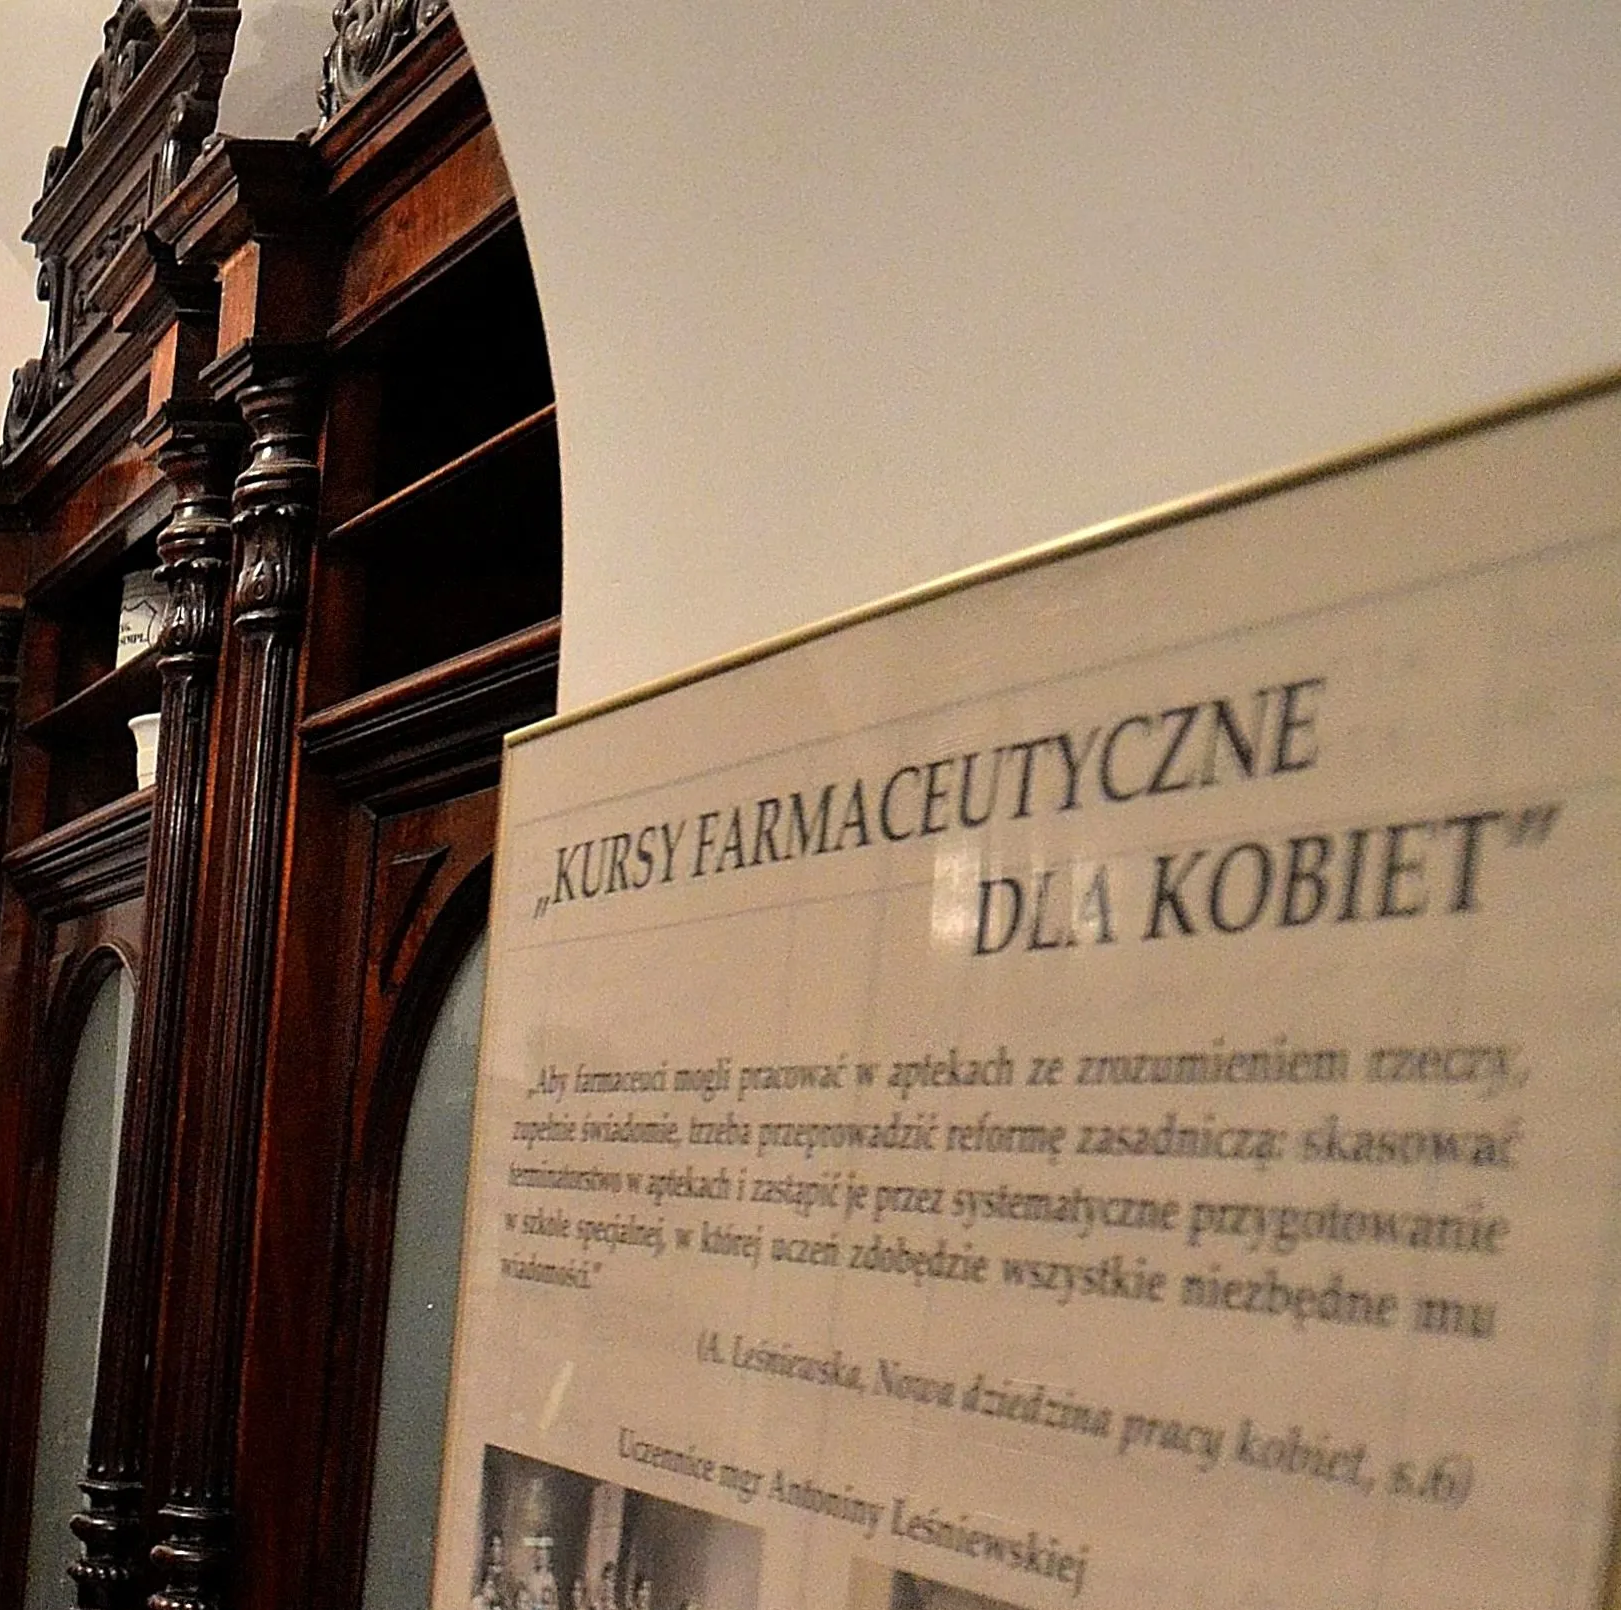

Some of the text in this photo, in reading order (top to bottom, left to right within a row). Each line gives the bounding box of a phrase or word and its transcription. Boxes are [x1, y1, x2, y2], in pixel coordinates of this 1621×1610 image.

[535, 675, 1326, 920] „KURSY FARMACEUTYCZNE
[972, 864, 1116, 957] DLA
[574, 1061, 666, 1093] farmaceuci
[674, 1057, 730, 1102] mogli
[738, 1053, 847, 1102] pracować
[855, 1063, 877, 1085] w
[887, 1046, 1013, 1101] aptekach
[1025, 1055, 1063, 1086] ze
[1074, 1034, 1349, 1086] zrozumieniem
[511, 1112, 576, 1150] zupełnie
[688, 1112, 751, 1145] trzeba
[757, 1111, 939, 1159] przeprowadzić
[947, 1111, 1066, 1166] reformę
[1302, 1113, 1524, 1168] skasować
[647, 1164, 730, 1207] aptekach
[736, 1167, 747, 1201] i
[844, 1170, 869, 1221] je
[875, 1185, 945, 1223] przez
[951, 1184, 1180, 1239] systematyczne
[1187, 1198, 1511, 1256] przygotowanie
[521, 1207, 570, 1238] szkole
[675, 1228, 694, 1250] w
[700, 1220, 764, 1269] której
[771, 1232, 843, 1266] uczeń
[848, 1234, 990, 1287] zdobędzie
[1002, 1255, 1165, 1307] wszystkie
[1180, 1262, 1399, 1332] niezbędne
[871, 1357, 955, 1407] Nowa
[960, 1373, 1113, 1438] dziedzina
[1119, 1413, 1225, 1472] pracy
[618, 1425, 1089, 1597] Uczennice mgr Antoniny Leśniewskiej
